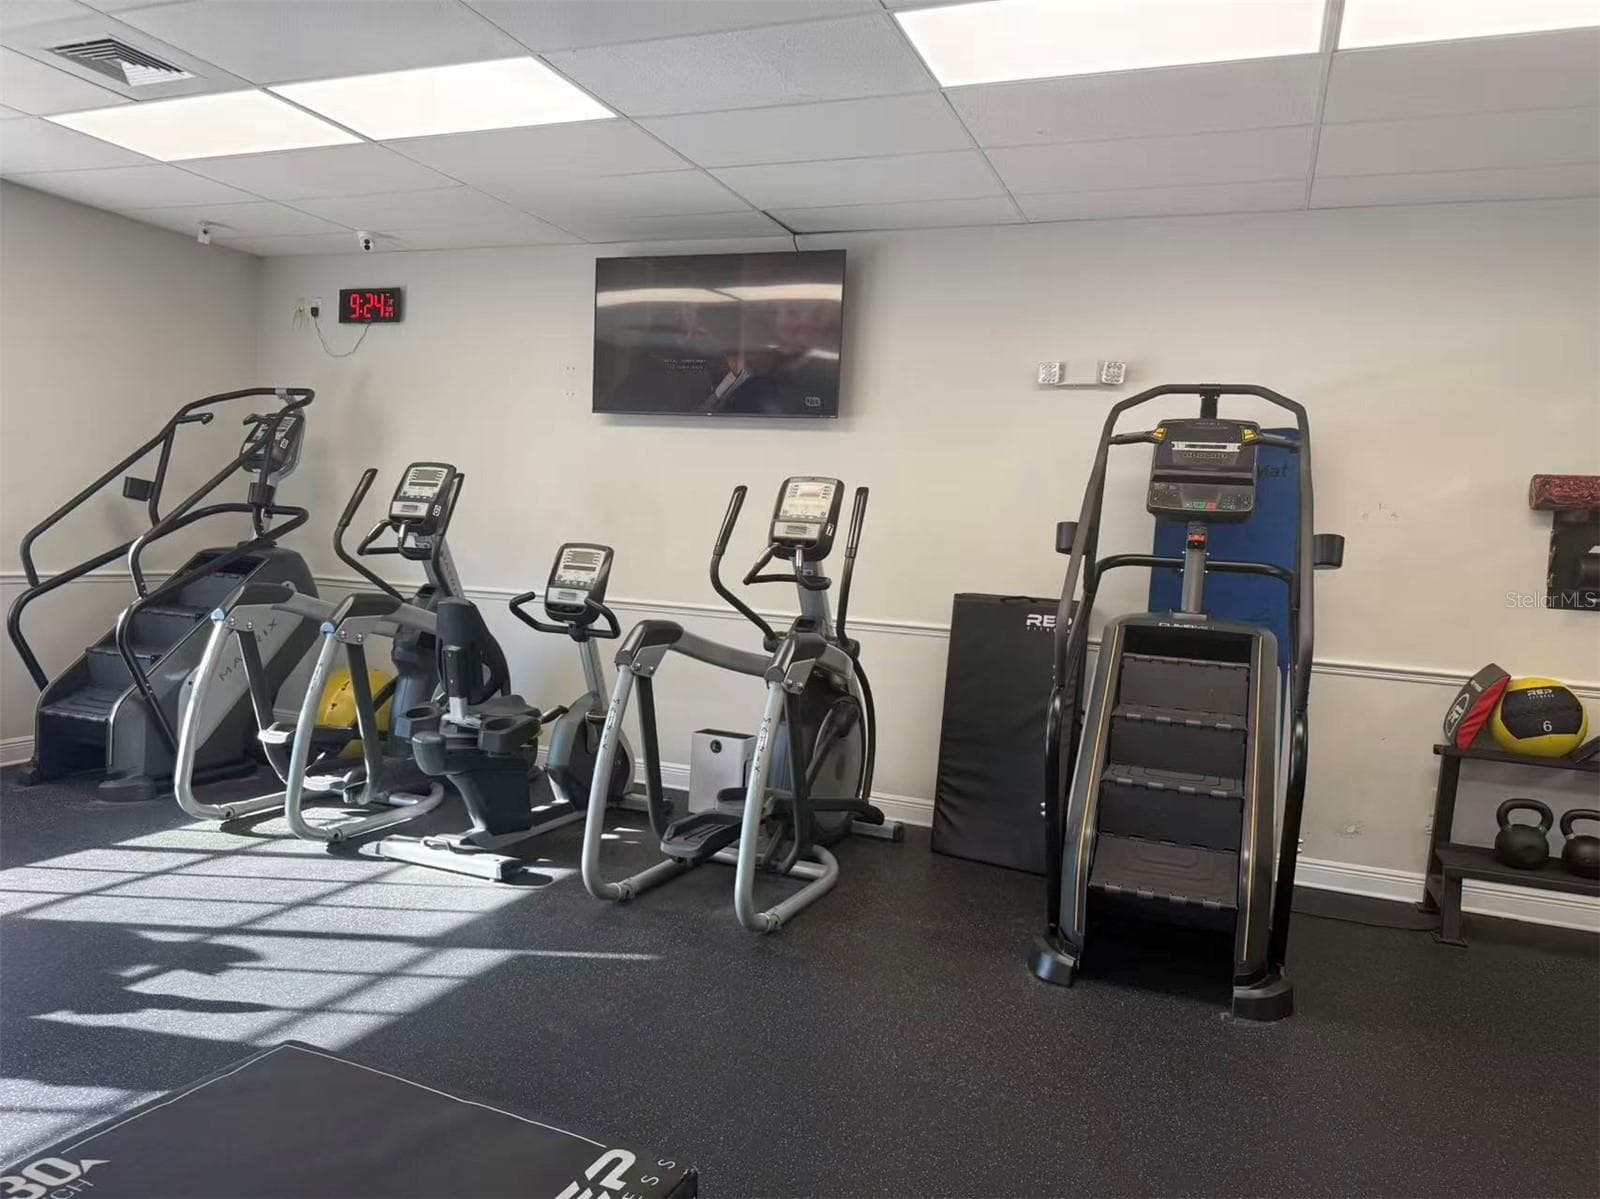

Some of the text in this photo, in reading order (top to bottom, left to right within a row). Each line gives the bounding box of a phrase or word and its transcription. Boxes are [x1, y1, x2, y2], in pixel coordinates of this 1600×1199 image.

[350, 293, 384, 319] 9:24
[1026, 613, 1072, 627] RE
[218, 618, 278, 682] MARIX
[1543, 720, 1552, 732] 6
[0, 1157, 81, 1199] 30
